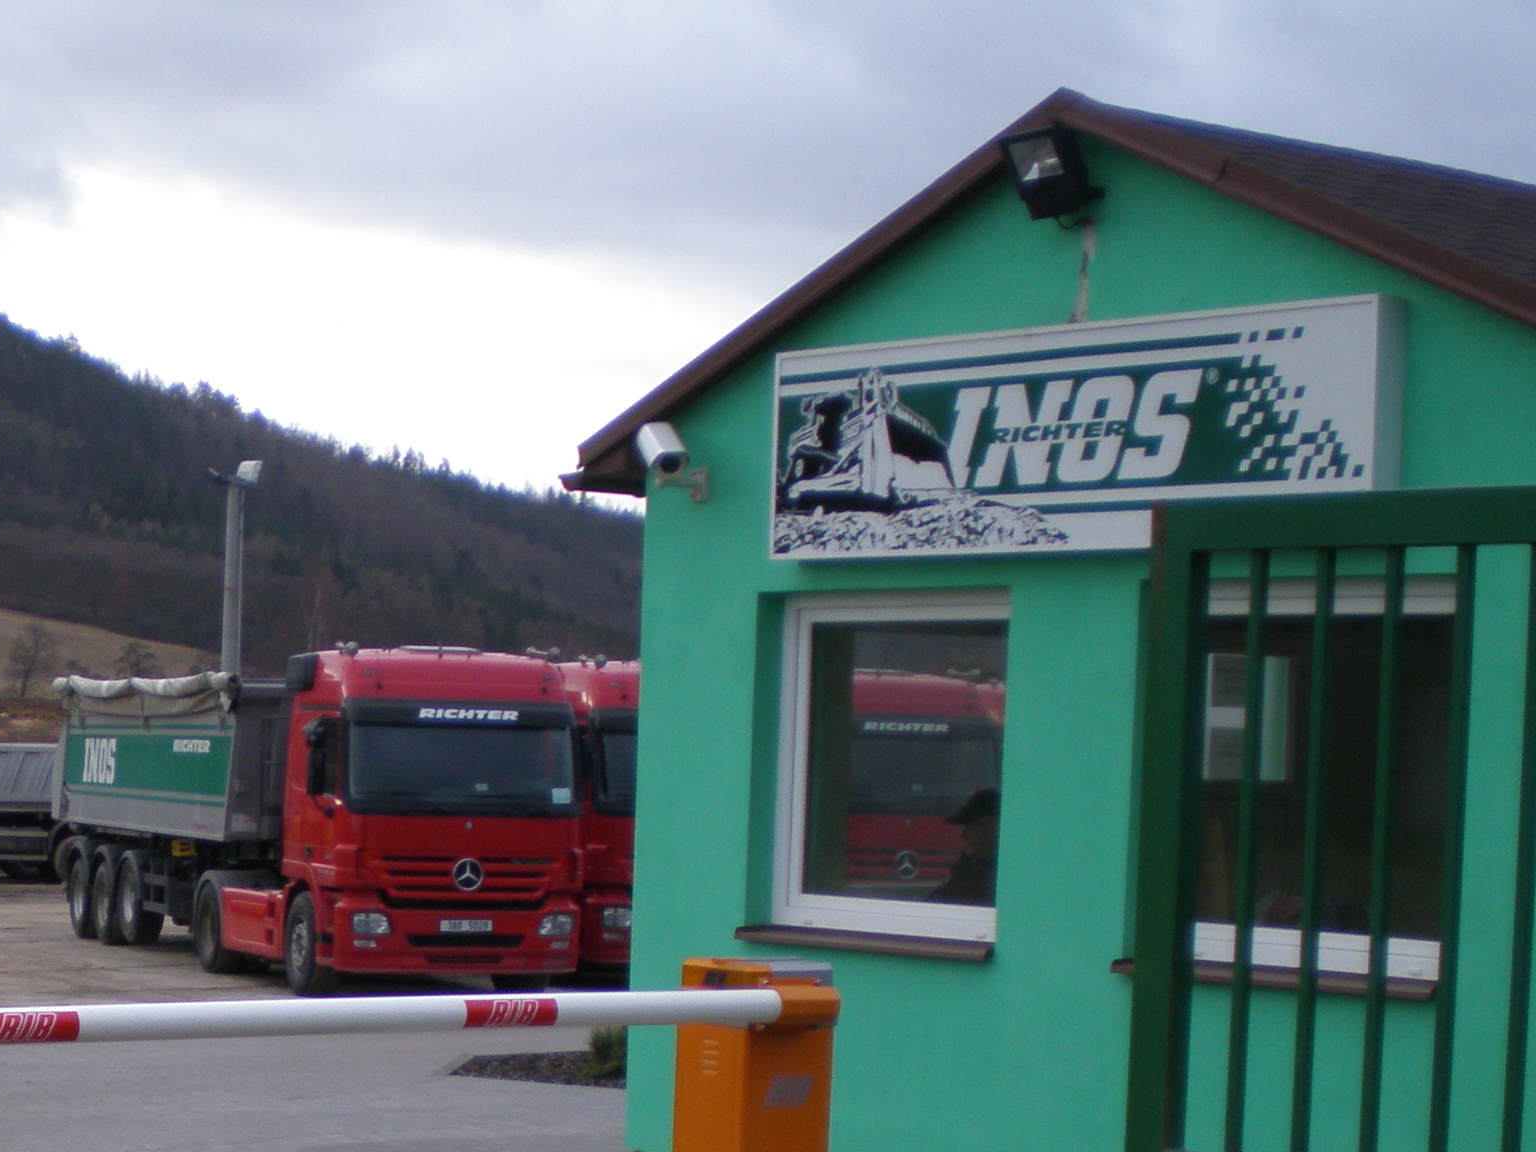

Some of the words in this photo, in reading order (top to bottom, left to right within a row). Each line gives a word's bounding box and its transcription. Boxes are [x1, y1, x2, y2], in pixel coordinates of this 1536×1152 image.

[949, 368, 1204, 488] INOS
[993, 419, 1129, 444] RICHTER
[418, 707, 519, 721] RICHTER
[864, 721, 949, 732] RICHTER
[172, 738, 211, 754] RICHTER
[82, 737, 117, 785] INOS
